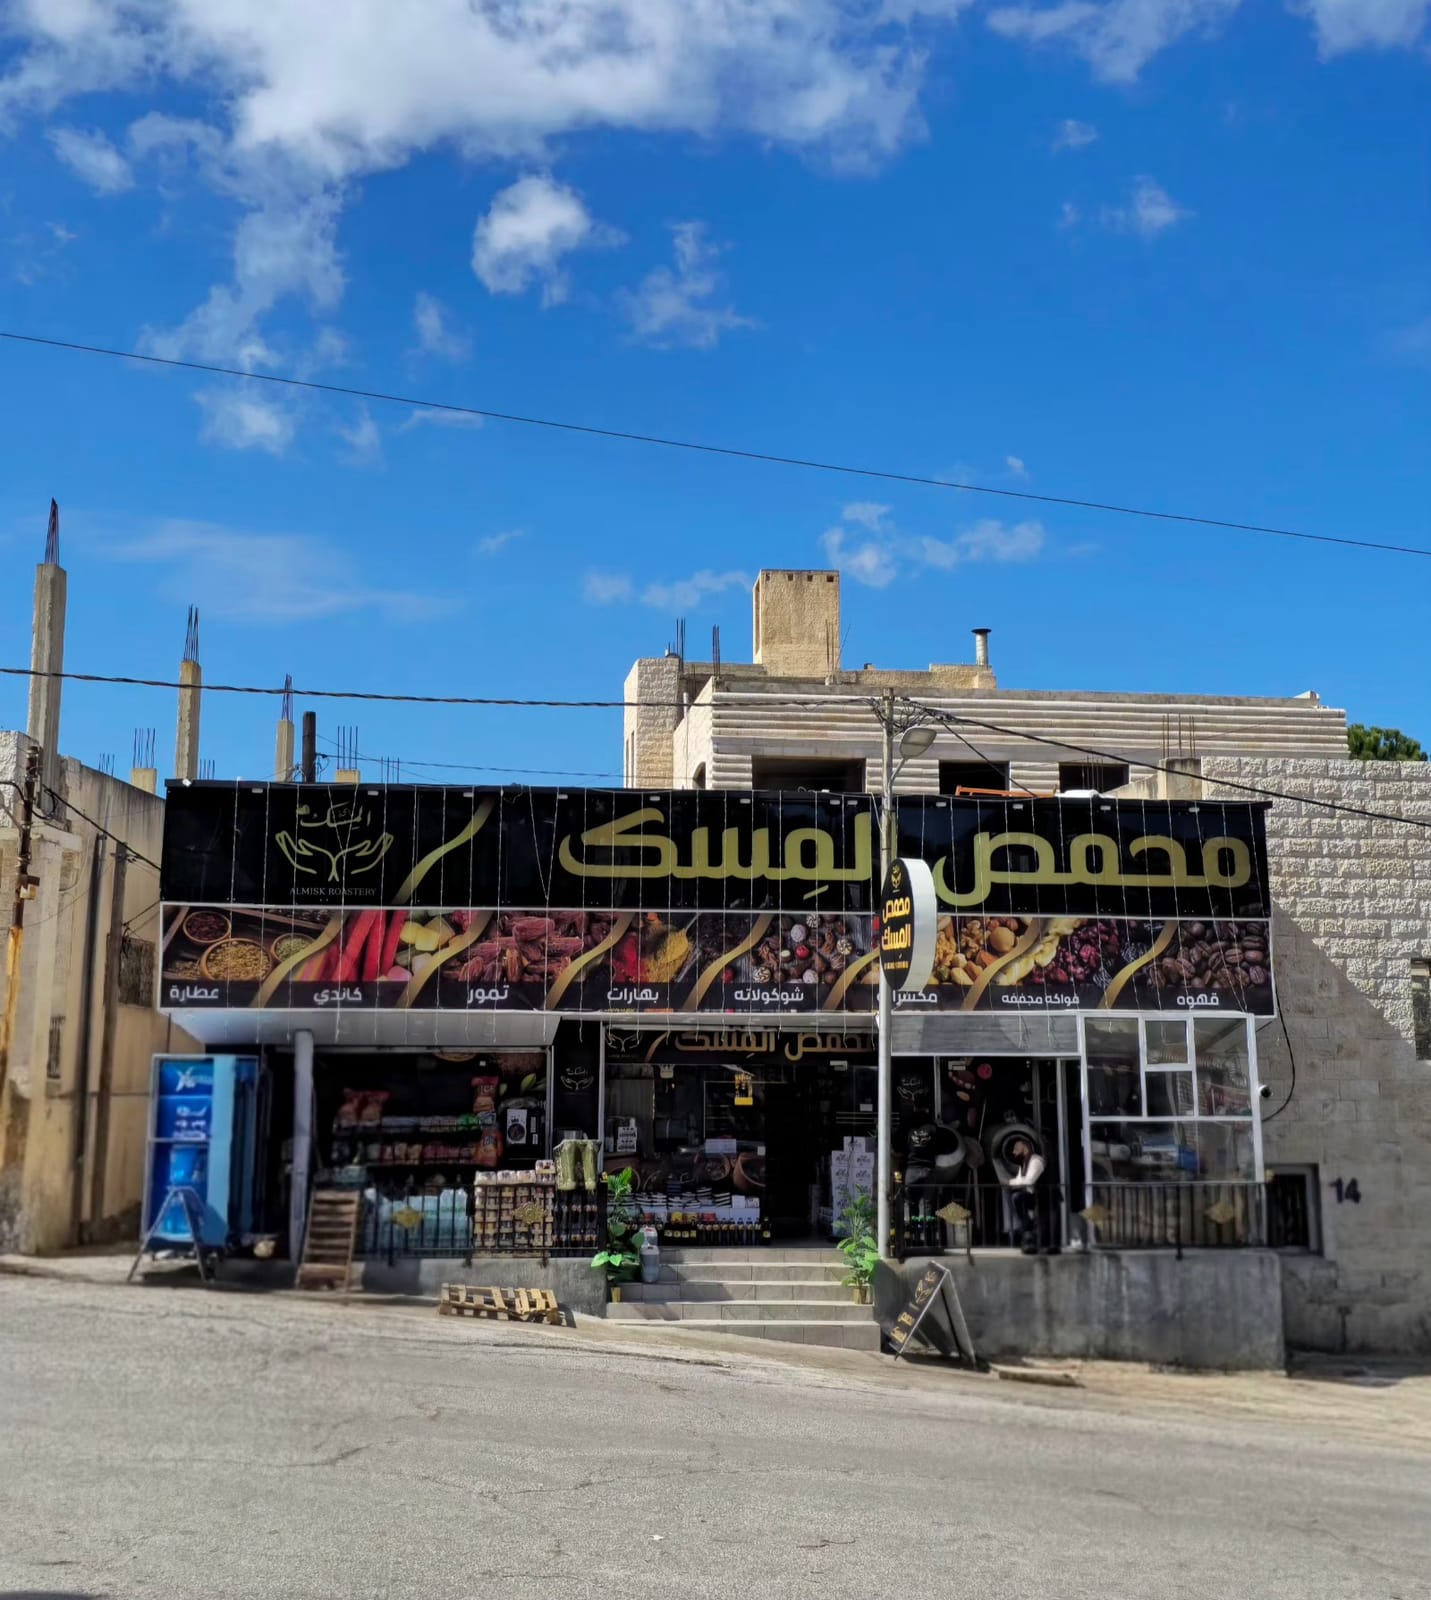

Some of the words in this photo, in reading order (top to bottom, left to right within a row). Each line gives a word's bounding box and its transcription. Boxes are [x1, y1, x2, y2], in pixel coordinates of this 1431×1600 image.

[932, 831, 1252, 907] محمص
[289, 887, 325, 896] ALMISK
[328, 887, 376, 896] ROASTERY
[882, 896, 911, 923] محمص
[169, 985, 218, 1001] عطارة
[314, 988, 362, 1005] كاندي
[466, 984, 509, 1006] تمور
[607, 988, 659, 1002] بهارات
[734, 988, 805, 1003] شوكولاته
[1045, 994, 1081, 1007] فواكه
[1000, 995, 1042, 1008] مجففه
[1329, 1177, 1361, 1204] 14
